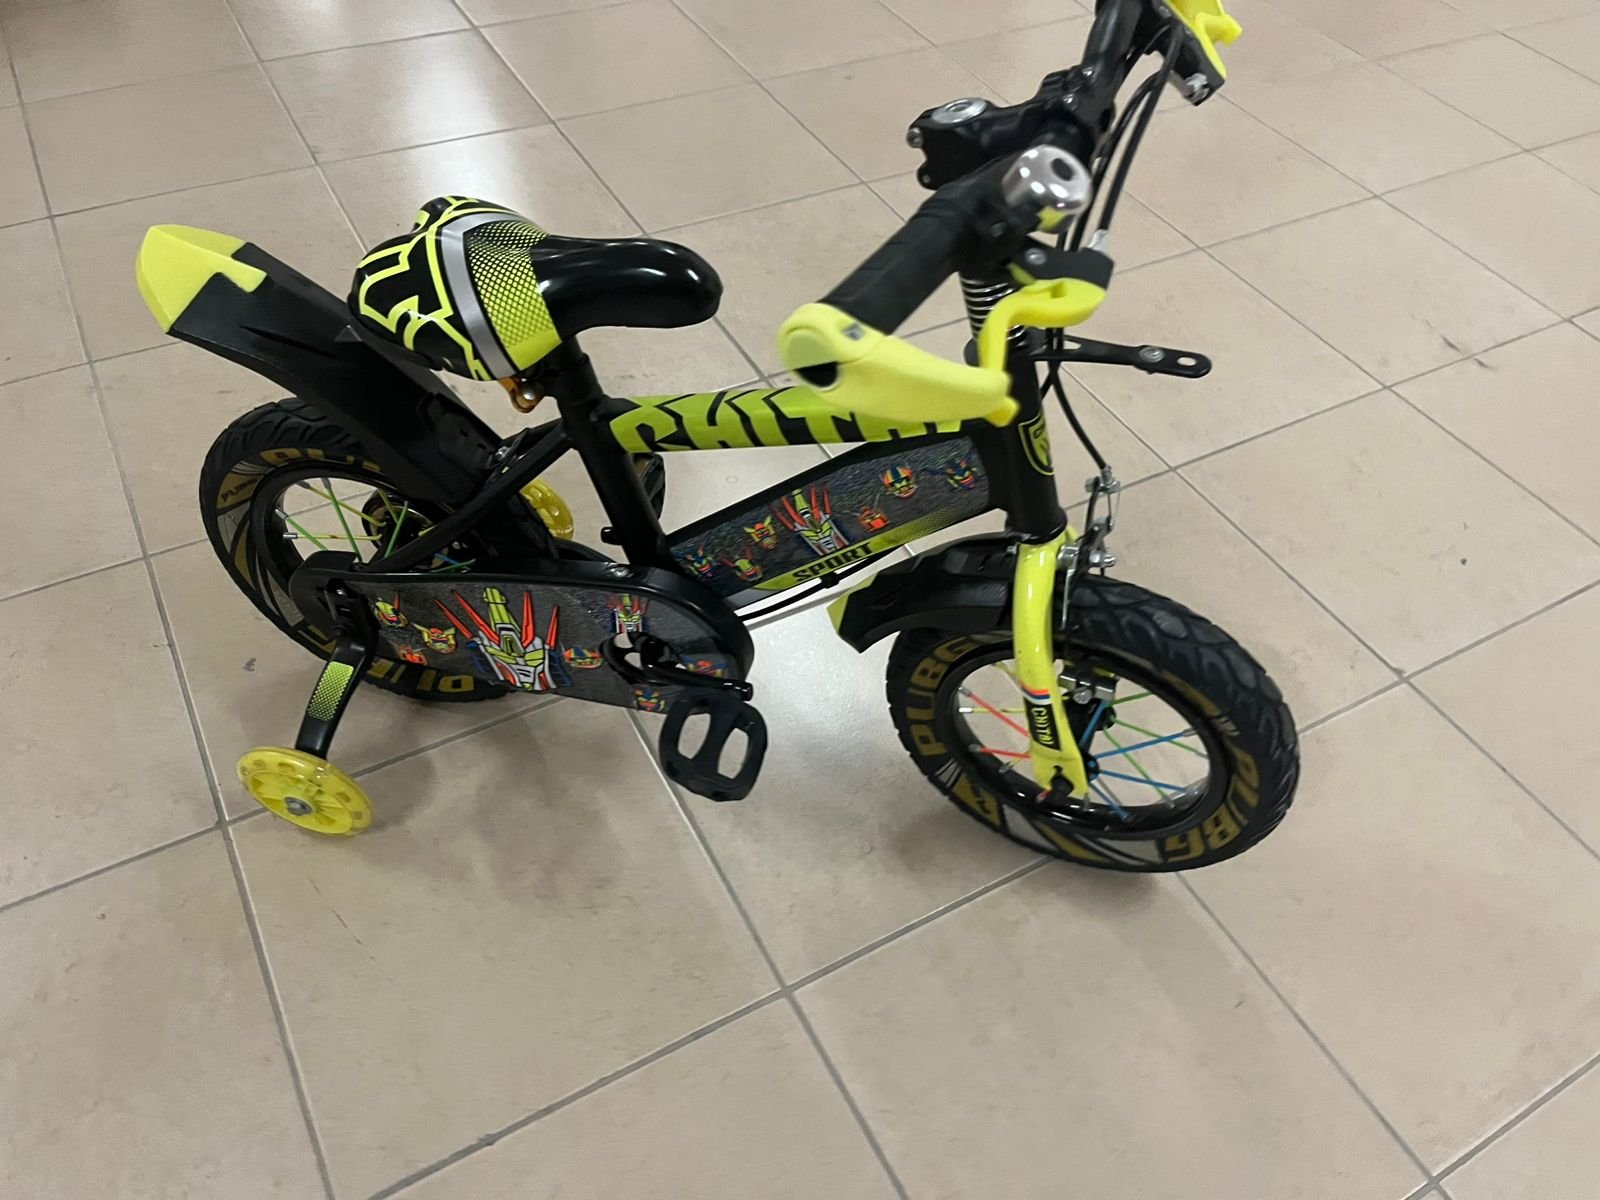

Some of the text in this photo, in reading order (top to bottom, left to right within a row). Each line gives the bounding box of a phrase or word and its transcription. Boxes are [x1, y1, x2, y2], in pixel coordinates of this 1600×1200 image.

[610, 386, 961, 454] CHIT
[793, 541, 873, 582] SPORT
[907, 636, 980, 757] PUBG
